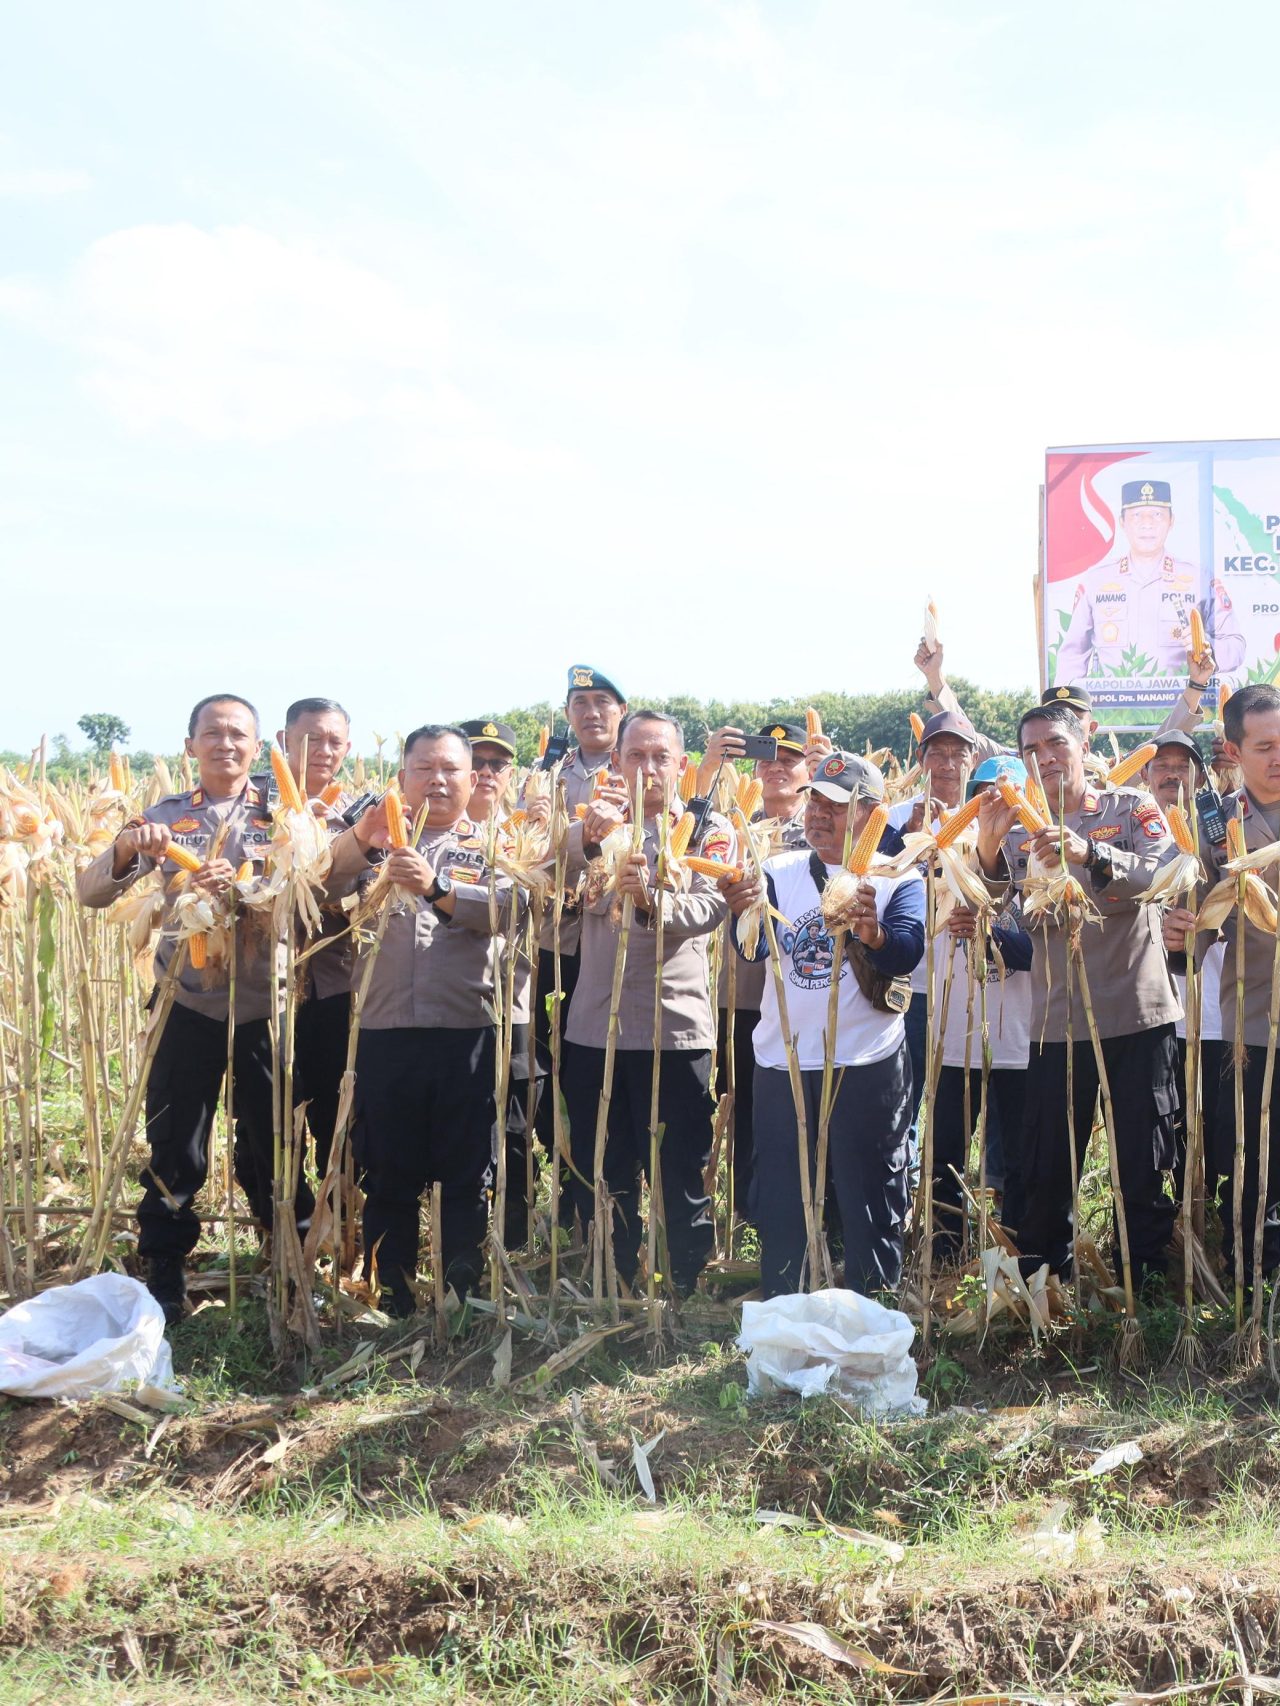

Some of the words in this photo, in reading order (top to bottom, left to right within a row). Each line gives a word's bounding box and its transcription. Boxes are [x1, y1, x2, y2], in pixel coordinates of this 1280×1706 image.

[1224, 555, 1276, 572] KEC.
[1096, 594, 1127, 603] NANANG
[1085, 678, 1142, 689] KAPOLDA
[1145, 678, 1180, 688] JAWA
[1183, 677, 1221, 687] TUR
[1099, 694, 1117, 702] POL
[1119, 694, 1135, 702] Drs.
[1137, 693, 1175, 702] NANANG
